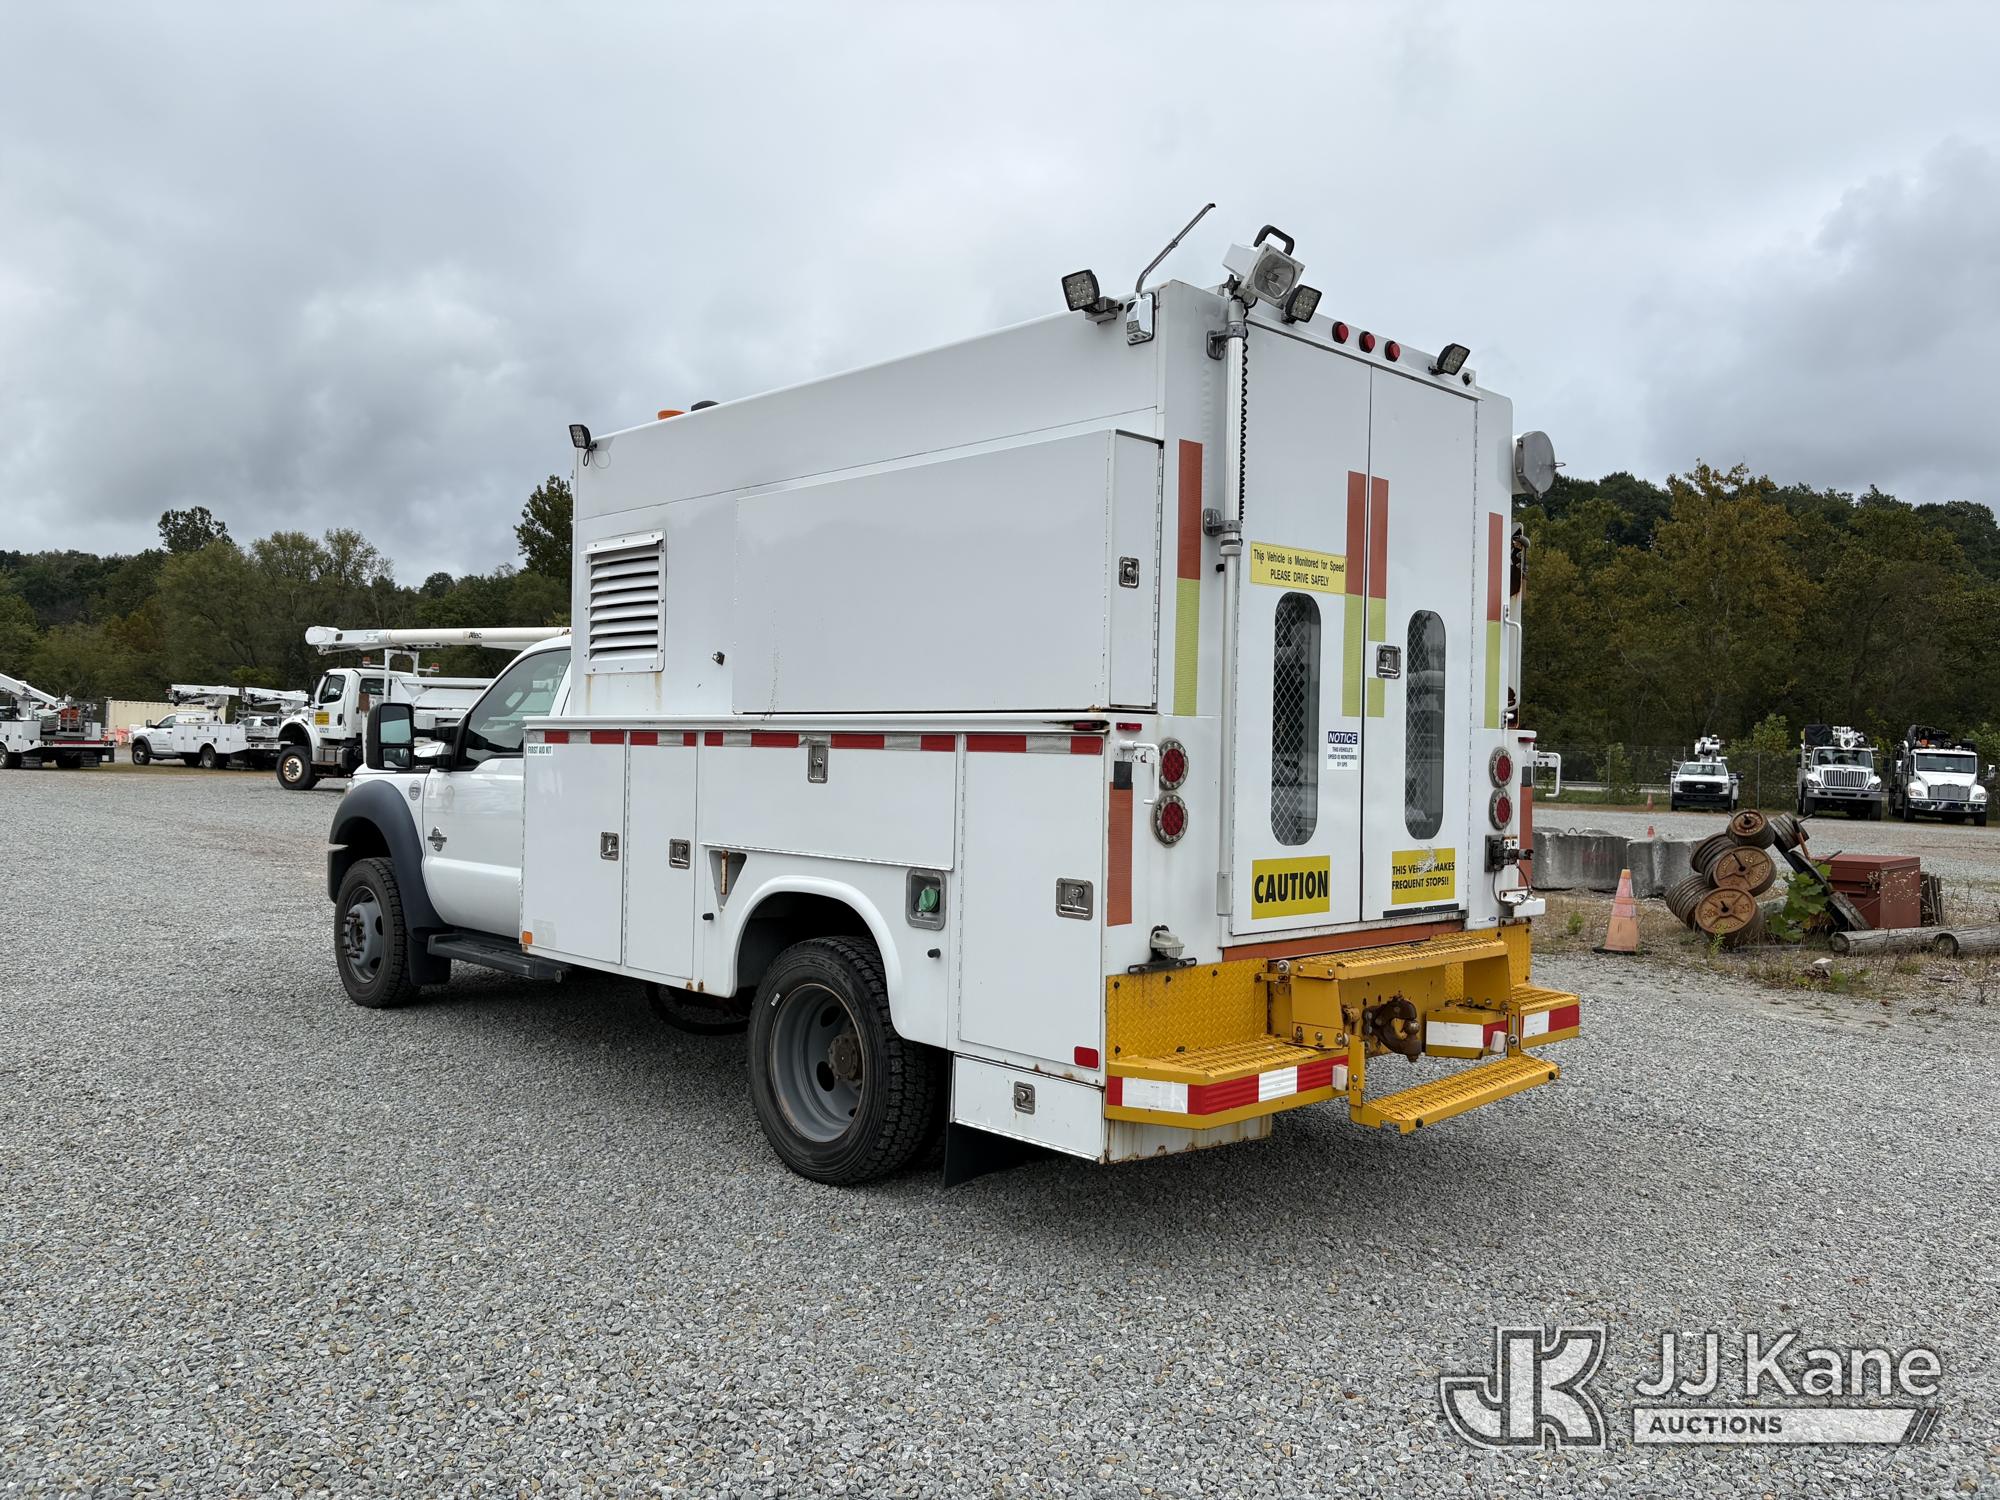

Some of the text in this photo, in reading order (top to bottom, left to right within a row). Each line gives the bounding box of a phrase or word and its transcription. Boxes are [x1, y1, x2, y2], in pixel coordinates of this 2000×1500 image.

[1253, 549, 1345, 574] This Vehicle is Monitored for Speed
[1270, 569, 1329, 586] PLEASE DRIVE SAFELY
[1328, 732, 1357, 743] NOTICE
[528, 745, 539, 755] FIRST
[1392, 865, 1407, 875] THIS
[1434, 862, 1455, 872] MAKES
[1254, 869, 1328, 904] CAUTION
[1392, 876, 1449, 890] FREQUENT STOPS!!
